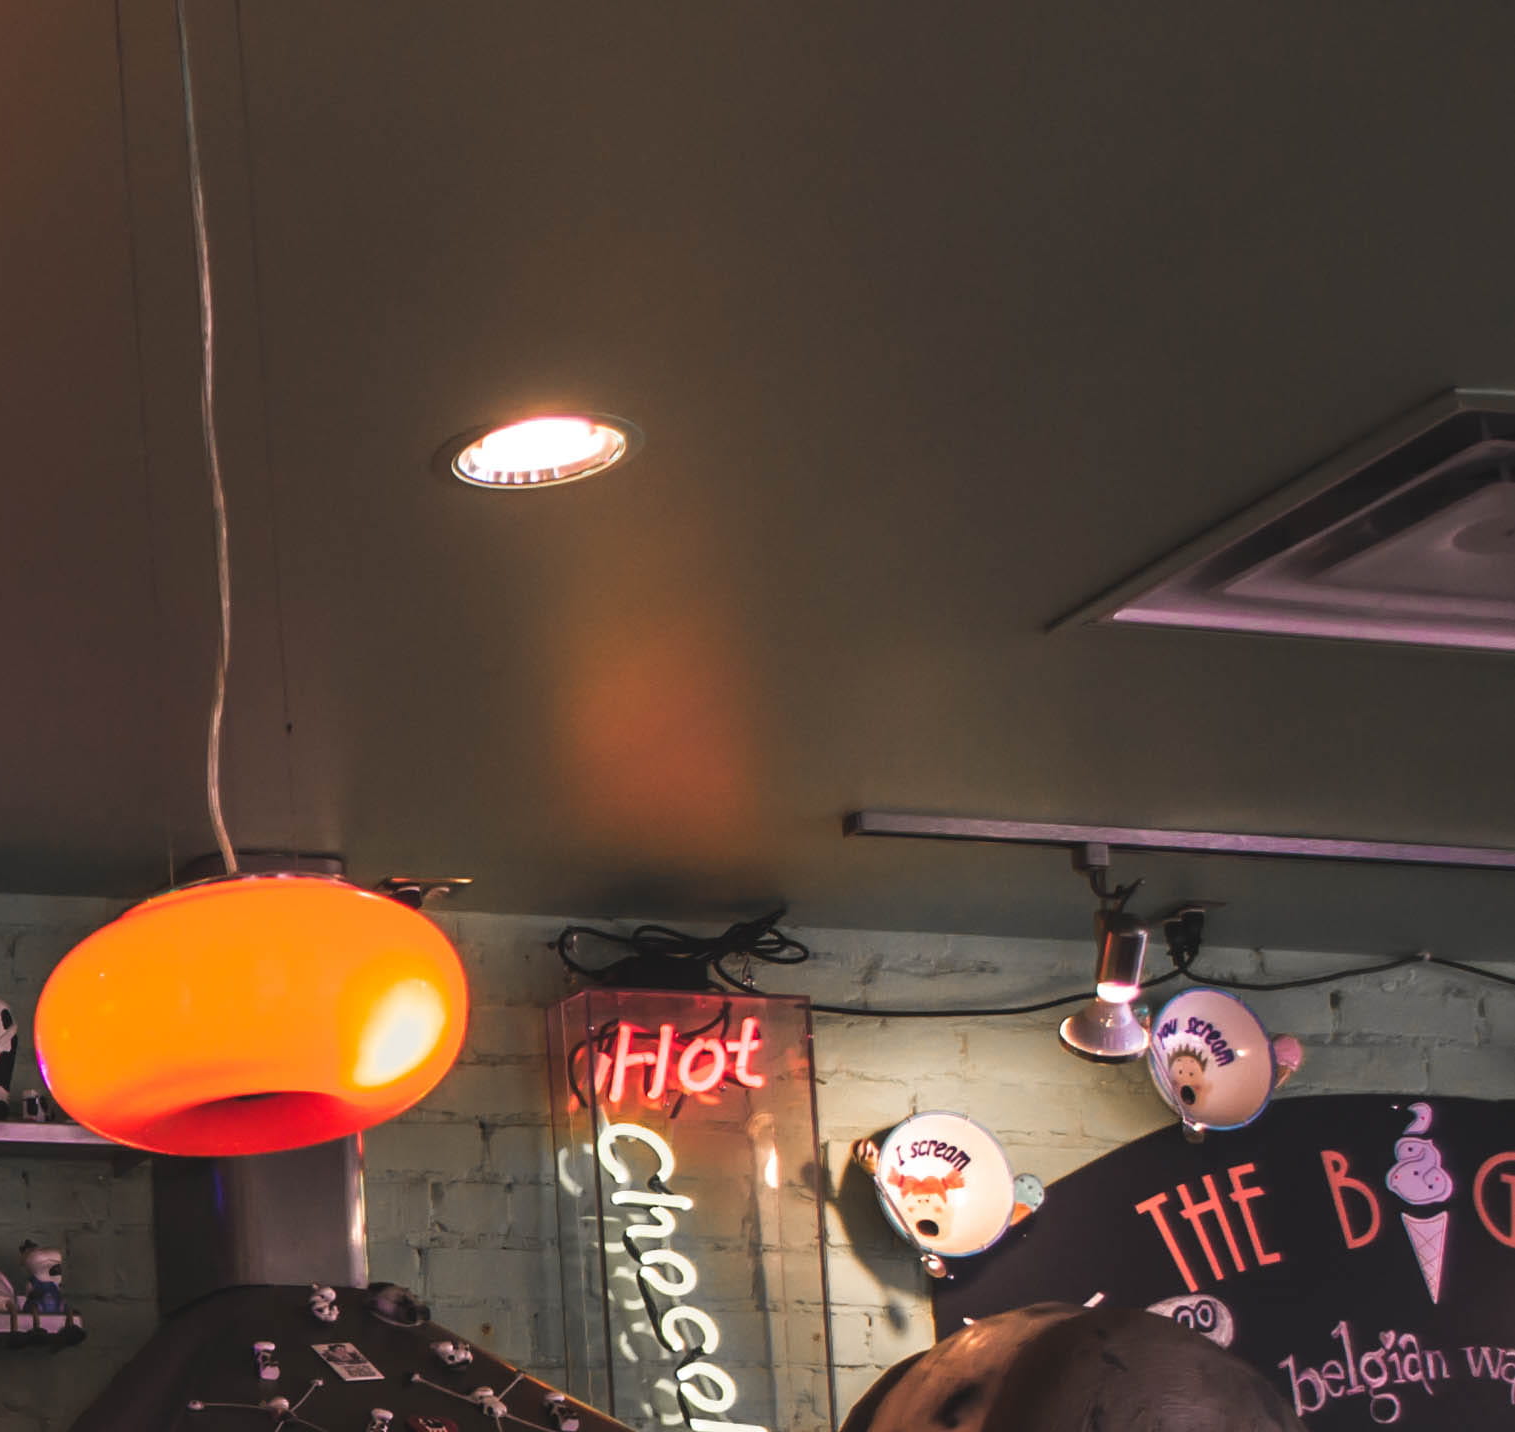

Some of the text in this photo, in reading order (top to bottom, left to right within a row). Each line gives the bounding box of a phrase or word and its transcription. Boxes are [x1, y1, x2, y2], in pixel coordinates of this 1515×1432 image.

[607, 1015, 766, 1104] Hot
[1187, 1015, 1236, 1068] scream
[910, 1137, 971, 1172] scream
[1135, 1163, 1285, 1294] THE
[1277, 1320, 1450, 1425] belgian
